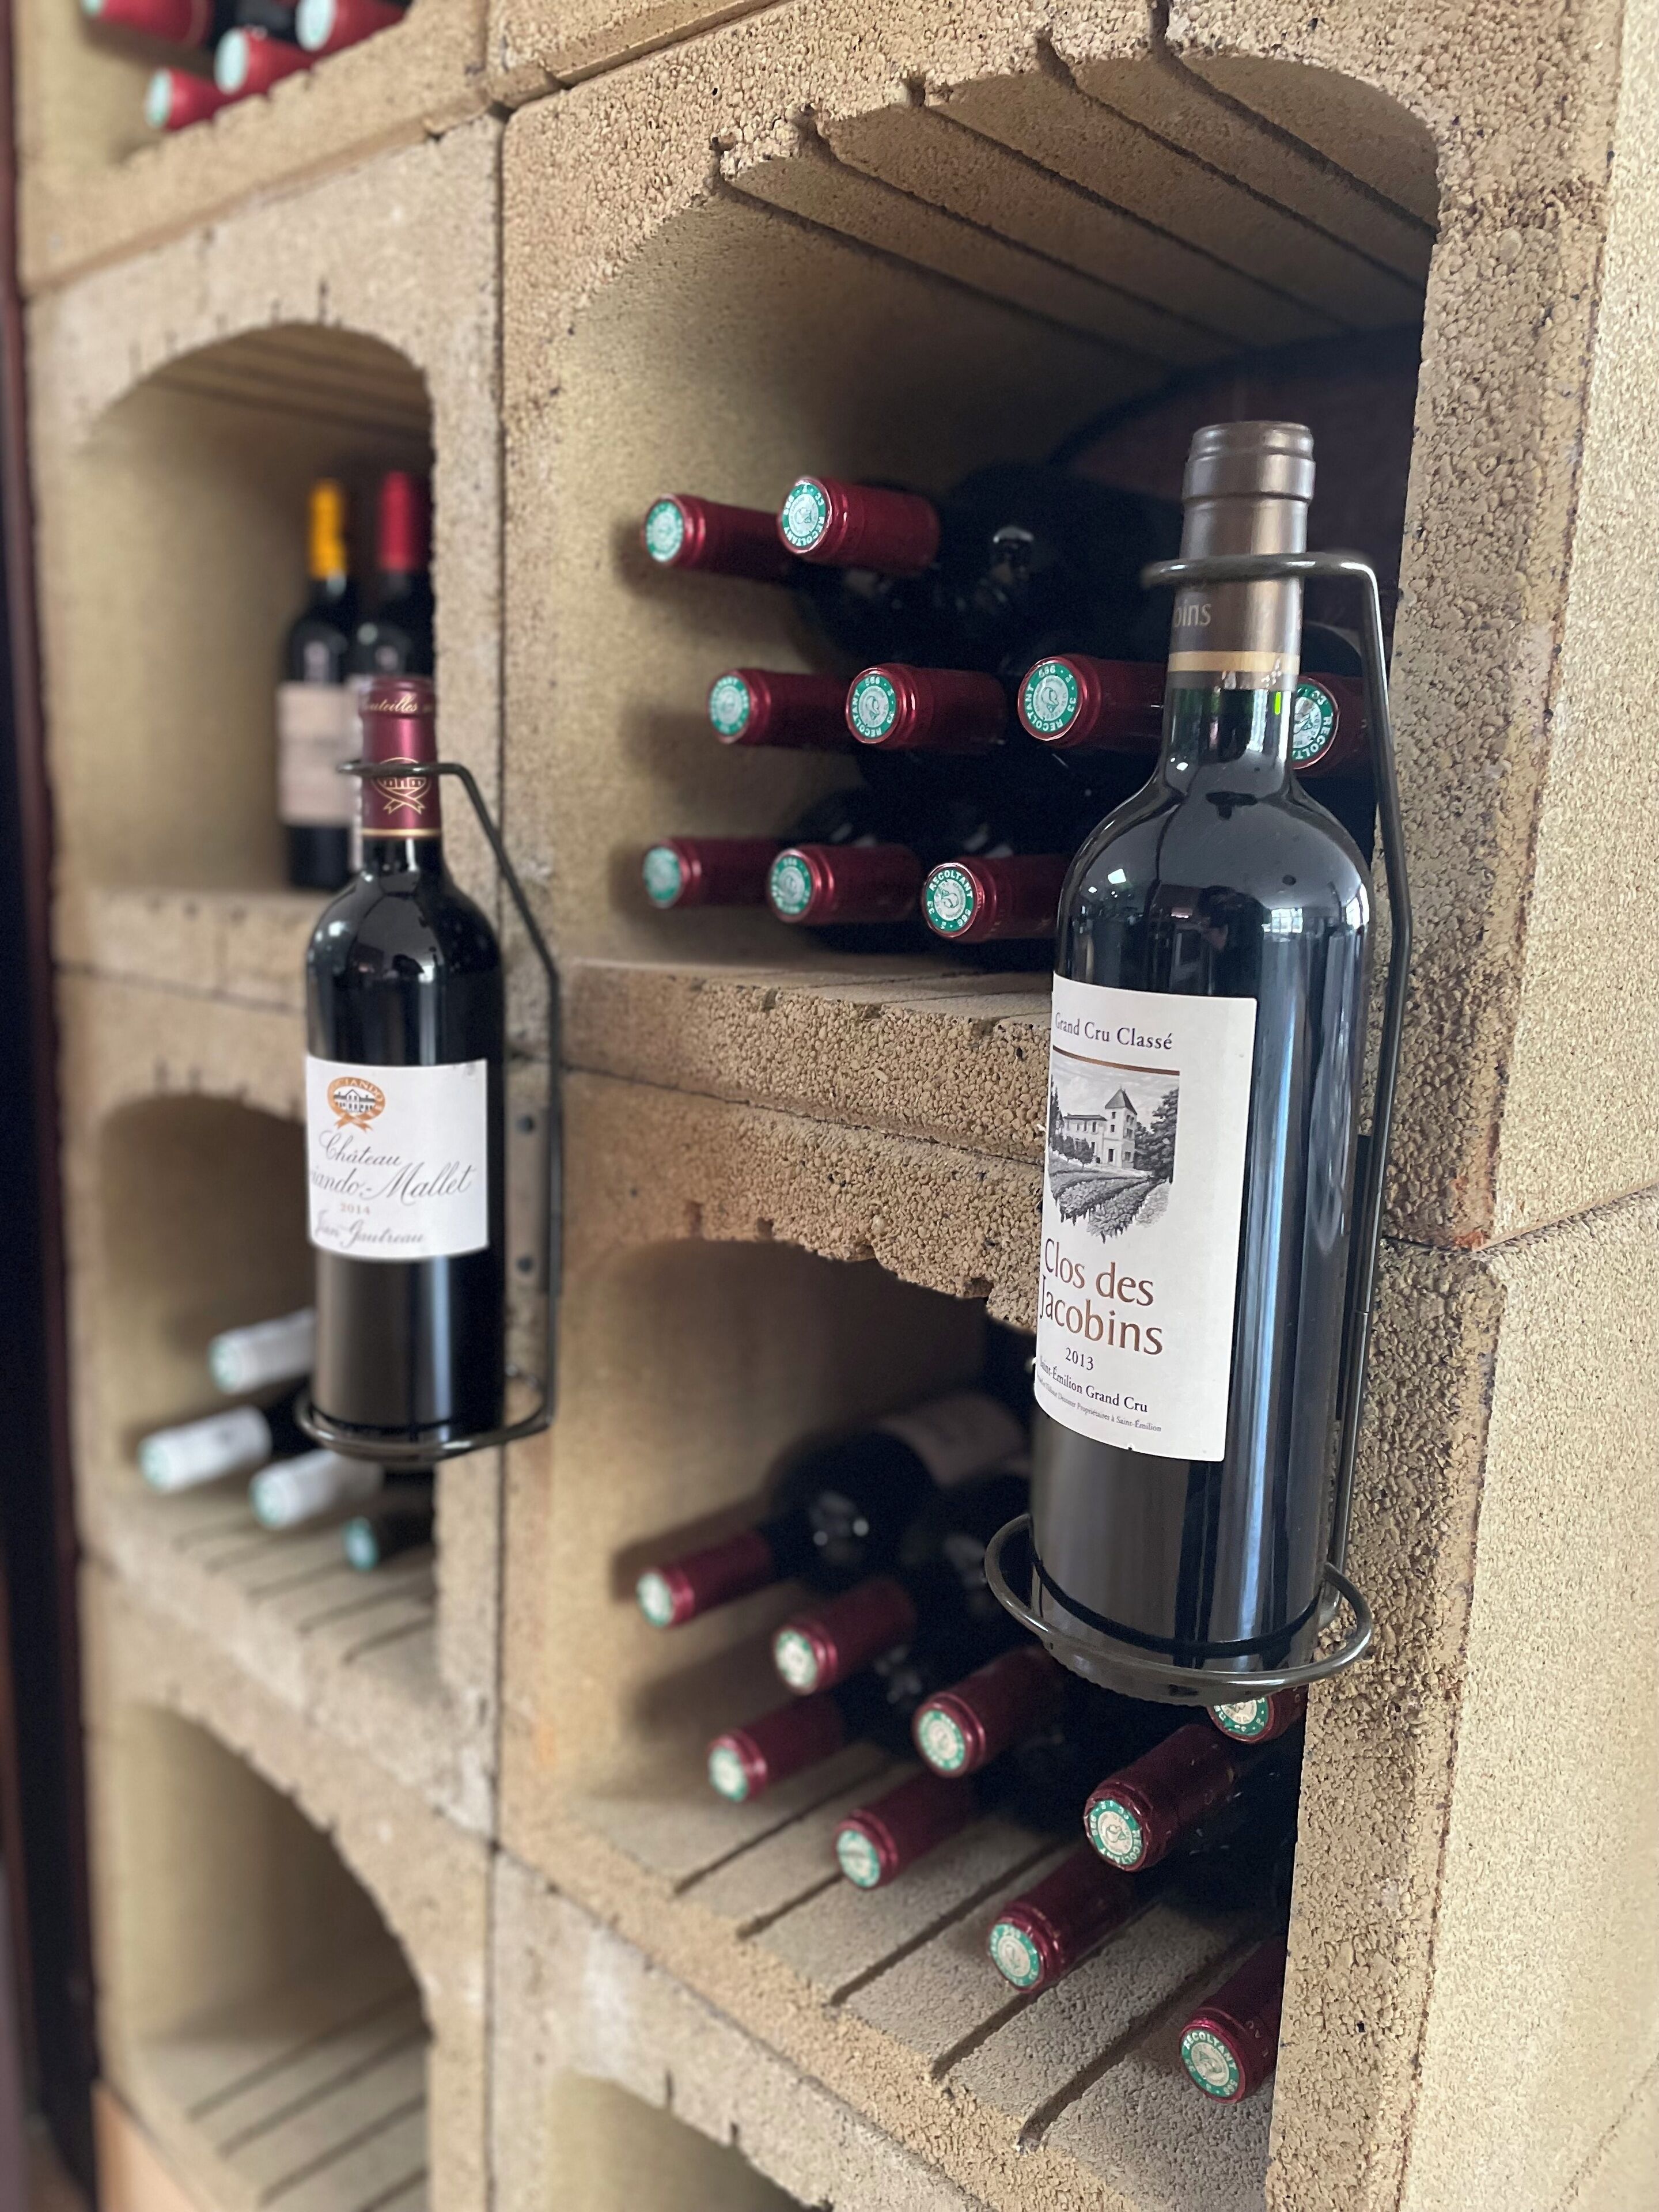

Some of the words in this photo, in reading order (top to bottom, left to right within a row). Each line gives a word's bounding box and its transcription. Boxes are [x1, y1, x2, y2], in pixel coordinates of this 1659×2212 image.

[815, 493, 824, 506] 33
[784, 516, 825, 547] RECOLTANT
[1039, 665, 1056, 678] 566
[852, 689, 882, 737] RECOLTANT
[1025, 684, 1063, 732] RECOLTANT
[1067, 698, 1077, 712] 33
[1311, 690, 1327, 706] 33
[1292, 715, 1333, 759] RECOLT
[929, 870, 973, 898] RECOLTANT
[927, 900, 935, 915] 33
[957, 909, 971, 927] 566
[1055, 1012, 1080, 1036] Grand
[1084, 1021, 1110, 1043] Cru
[1116, 1027, 1173, 1051] Classé
[319, 1130, 402, 1165] Château
[311, 1160, 477, 1206] iando-Mallet
[340, 1202, 370, 1215] 2014
[1044, 1238, 1085, 1289] Clos
[1095, 1262, 1154, 1306] des
[1040, 1274, 1164, 1355] Jacobins
[1065, 1347, 1094, 1371] 2013
[1040, 1355, 1083, 1394] Saint-Émilion
[1086, 1385, 1120, 1407] Grand
[1124, 1396, 1148, 1412] Cru
[1116, 1416, 1162, 1432] Saint-Émilion
[1100, 1830, 1142, 1865] RECOLTANT
[1183, 2031, 1237, 2070] RECOLTANT
